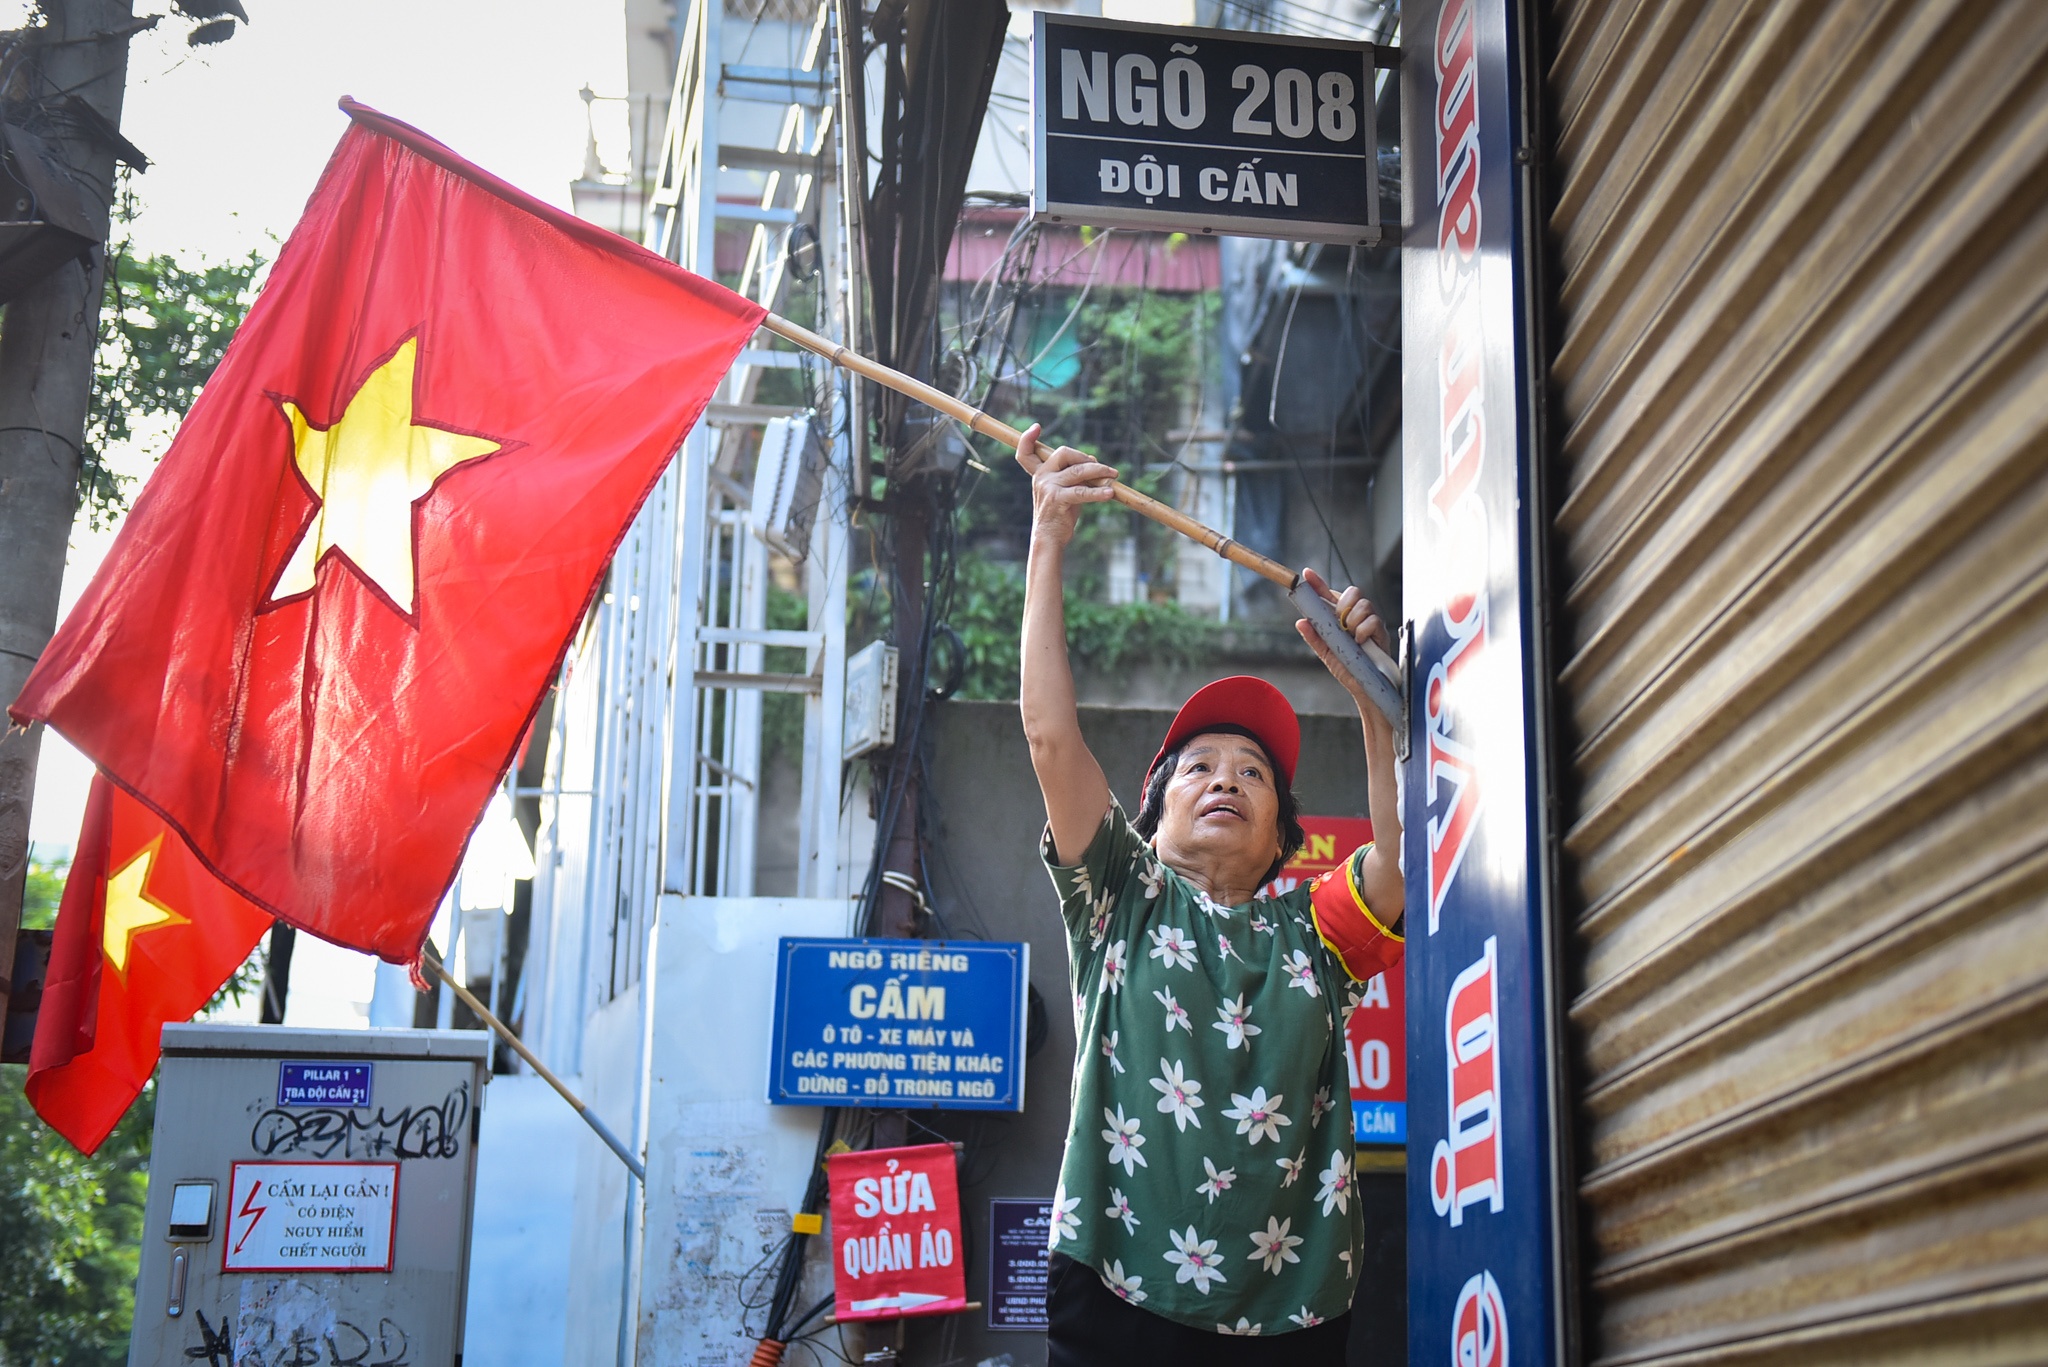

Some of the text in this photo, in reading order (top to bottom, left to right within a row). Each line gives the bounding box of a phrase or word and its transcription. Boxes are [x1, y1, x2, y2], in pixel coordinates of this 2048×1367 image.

[1061, 42, 1357, 142] NGÕ 208
[1098, 154, 1299, 207] ĐỘI CẤN
[890, 951, 969, 972] RIÊNG
[849, 974, 946, 1020] CẤM
[822, 1024, 836, 1044] Ô
[840, 1024, 862, 1045] TÔ
[879, 1028, 902, 1045] XE
[906, 1027, 947, 1047] MÁY
[951, 1028, 975, 1047] VÀ
[792, 1049, 1004, 1075] CÁC PHƯƠNG TIỆN KHÁC
[303, 1069, 349, 1081] PILLAR 1
[797, 1073, 848, 1094] DỪNG
[864, 1073, 889, 1095] ĐỖ
[894, 1078, 953, 1097] TRONG
[957, 1078, 995, 1098] NGÕ
[1431, 934, 1504, 1228] in
[285, 1087, 305, 1098] TBA
[328, 1084, 351, 1099] CẤN
[352, 1088, 365, 1099] 21
[1362, 1104, 1396, 1134] CẤN
[268, 1178, 306, 1197] CẤM
[310, 1184, 339, 1201] LẠI
[854, 1159, 936, 1218] SỬA
[321, 1205, 355, 1221] ĐIỆN
[285, 1221, 364, 1239] NGUY HIỂM
[279, 1242, 367, 1258] CHẾT NGƯỜI
[843, 1222, 953, 1280] QUẦN ÁO
